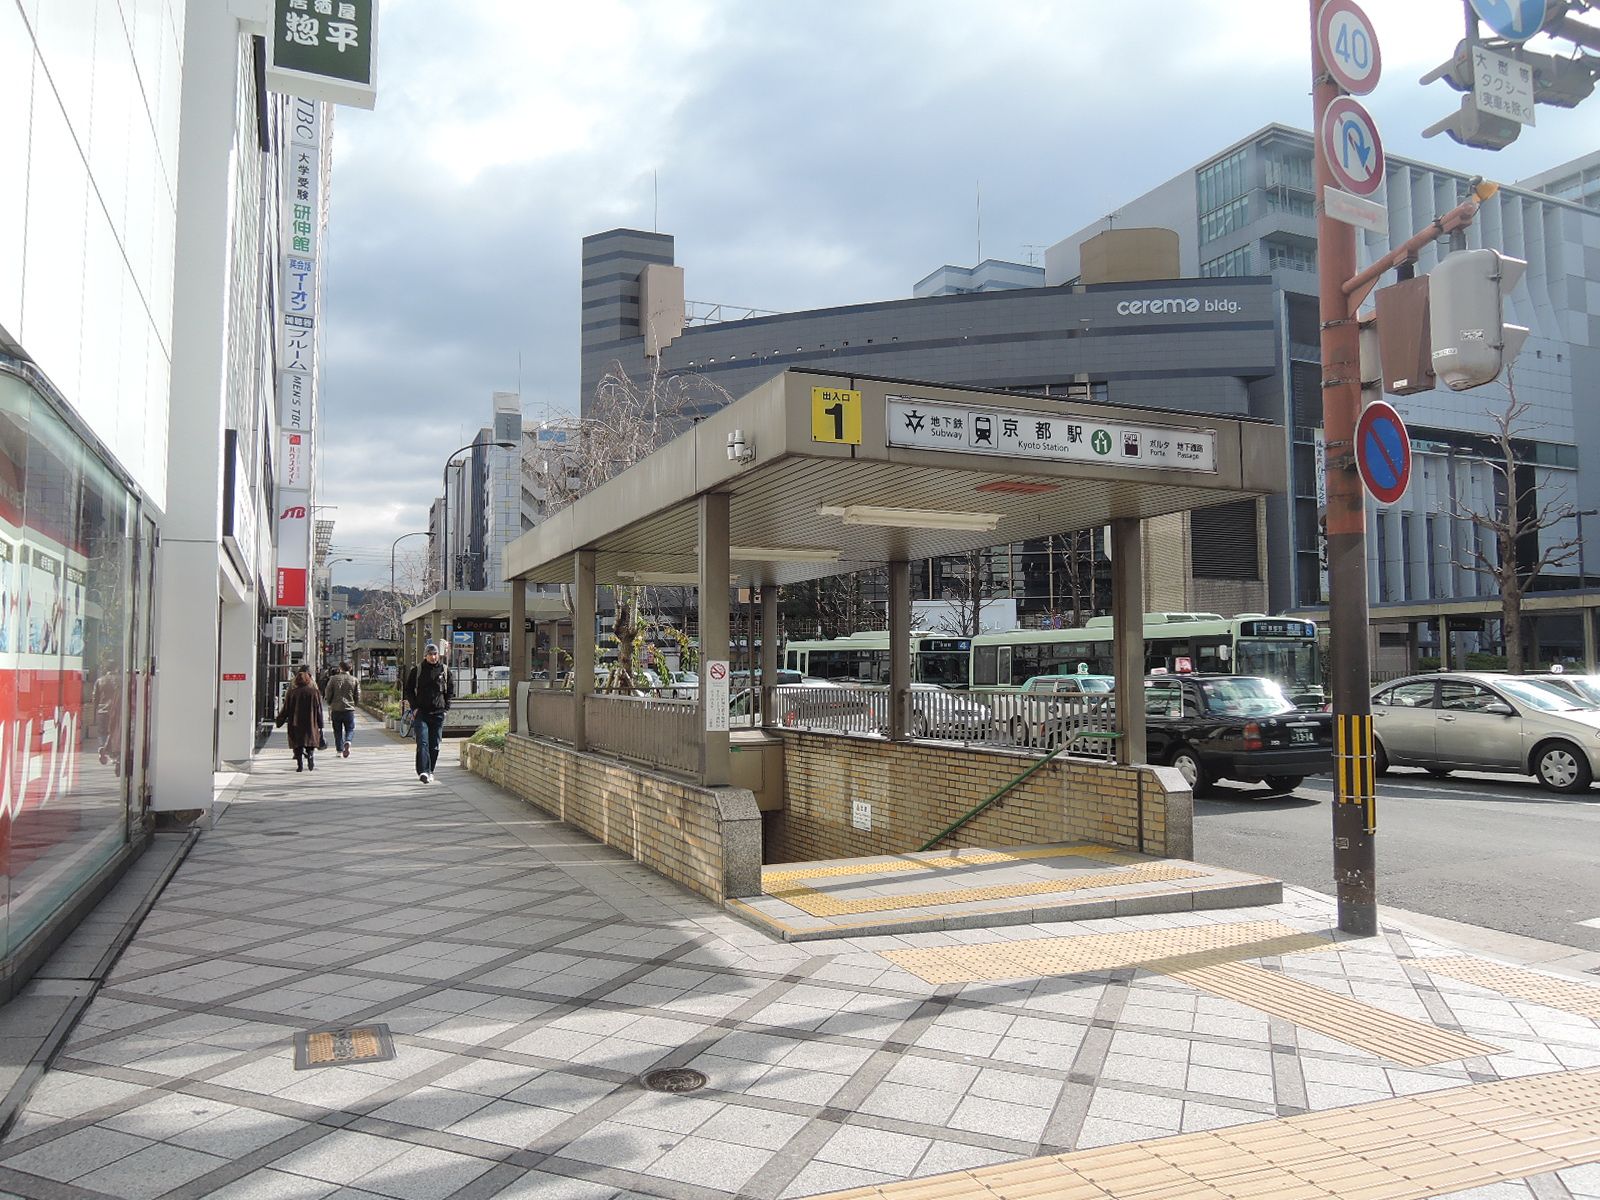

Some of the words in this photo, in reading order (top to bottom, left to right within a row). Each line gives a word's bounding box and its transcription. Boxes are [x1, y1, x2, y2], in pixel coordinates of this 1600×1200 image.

[1335, 22, 1368, 69] 40
[1482, 73, 1527, 96] タクシー
[297, 152, 310, 201] 大学受験
[292, 203, 311, 253] 研伸館
[291, 272, 308, 311] イーオン
[1205, 299, 1241, 313] bldg.
[823, 391, 850, 401] 出入口
[824, 403, 843, 440] 1
[930, 415, 963, 430] 地下鉄
[931, 428, 963, 441] Subway
[1002, 418, 1083, 444] 京都駅
[1018, 440, 1041, 451] Kyoto
[1042, 442, 1069, 453] Station
[1094, 438, 1108, 452] 11
[280, 506, 306, 520] JTB
[959, 641, 967, 649] 4
